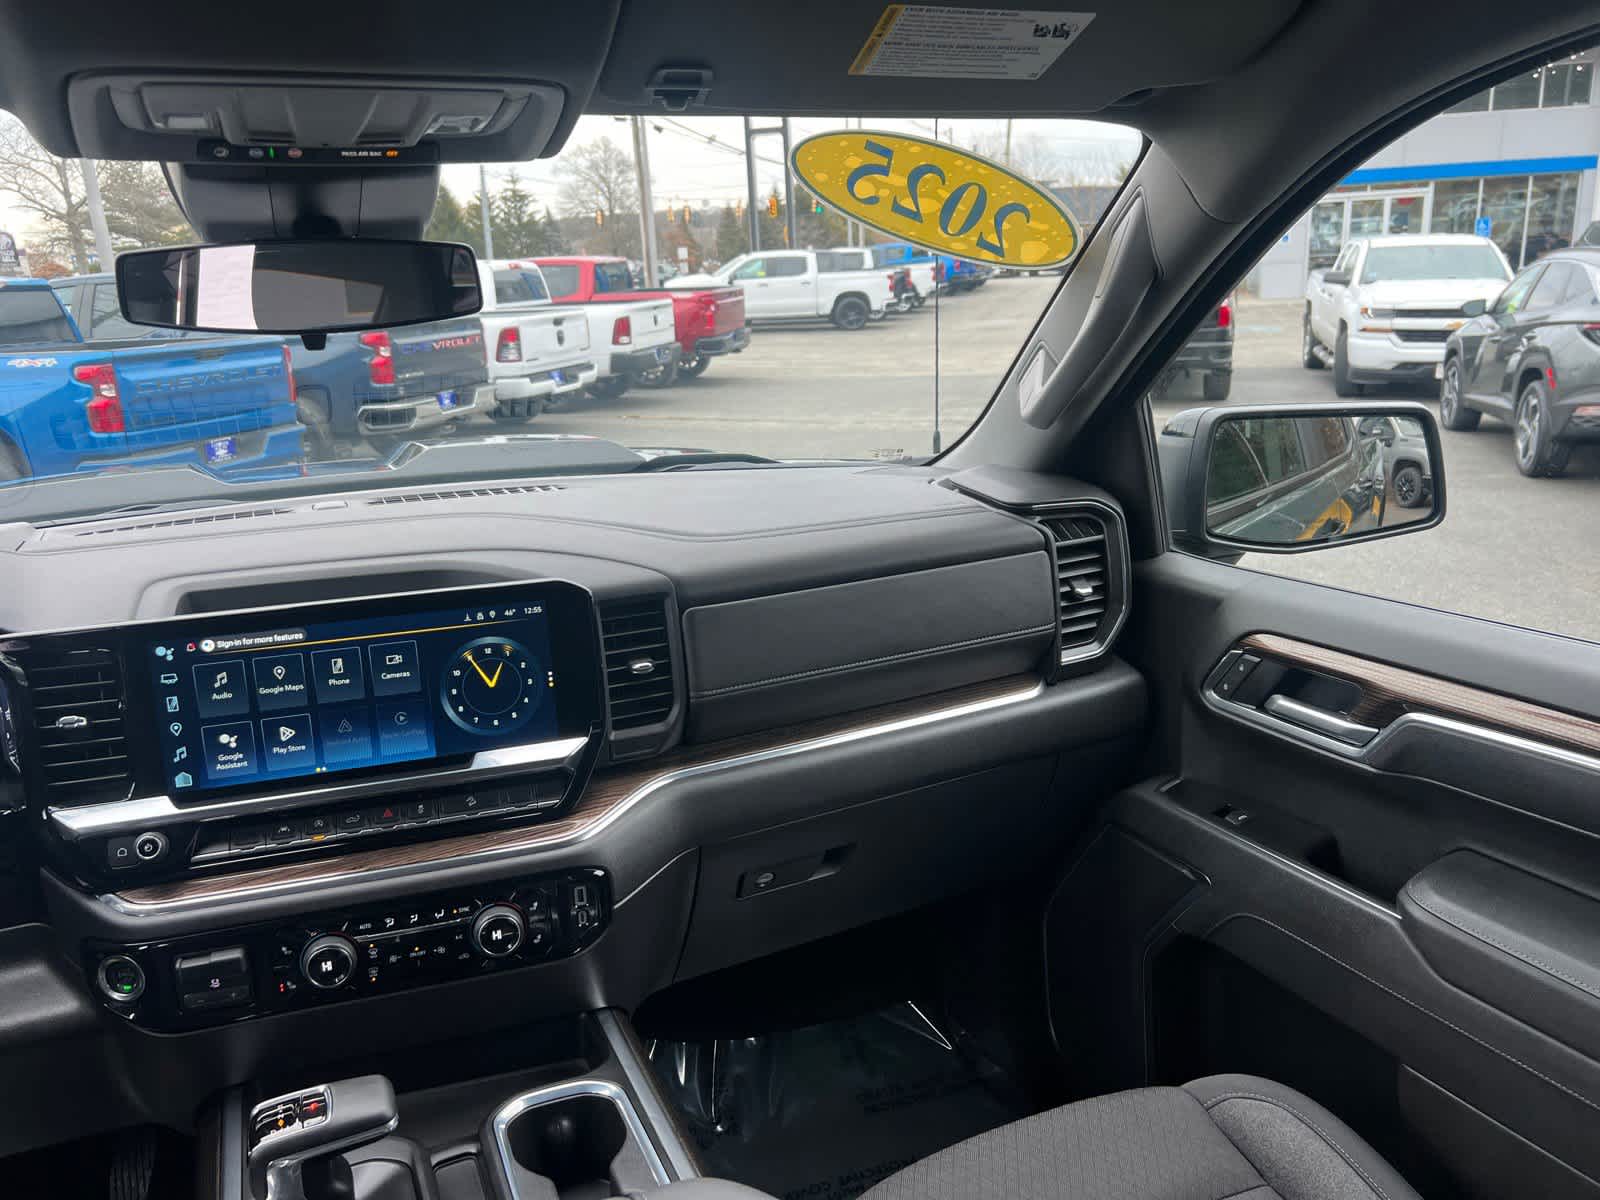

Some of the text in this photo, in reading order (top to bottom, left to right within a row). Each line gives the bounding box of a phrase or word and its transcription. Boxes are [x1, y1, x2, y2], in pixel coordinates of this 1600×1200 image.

[136, 366, 282, 393] CHEVROLET
[242, 637, 254, 647] for
[254, 636, 273, 645] more
[274, 632, 303, 643] features
[381, 670, 410, 680] Cameras
[328, 678, 350, 686] Phone
[259, 683, 304, 695] Google Maps
[212, 692, 232, 700] Audio
[273, 744, 306, 754] Play Store
[216, 752, 248, 770] Google Assistant
